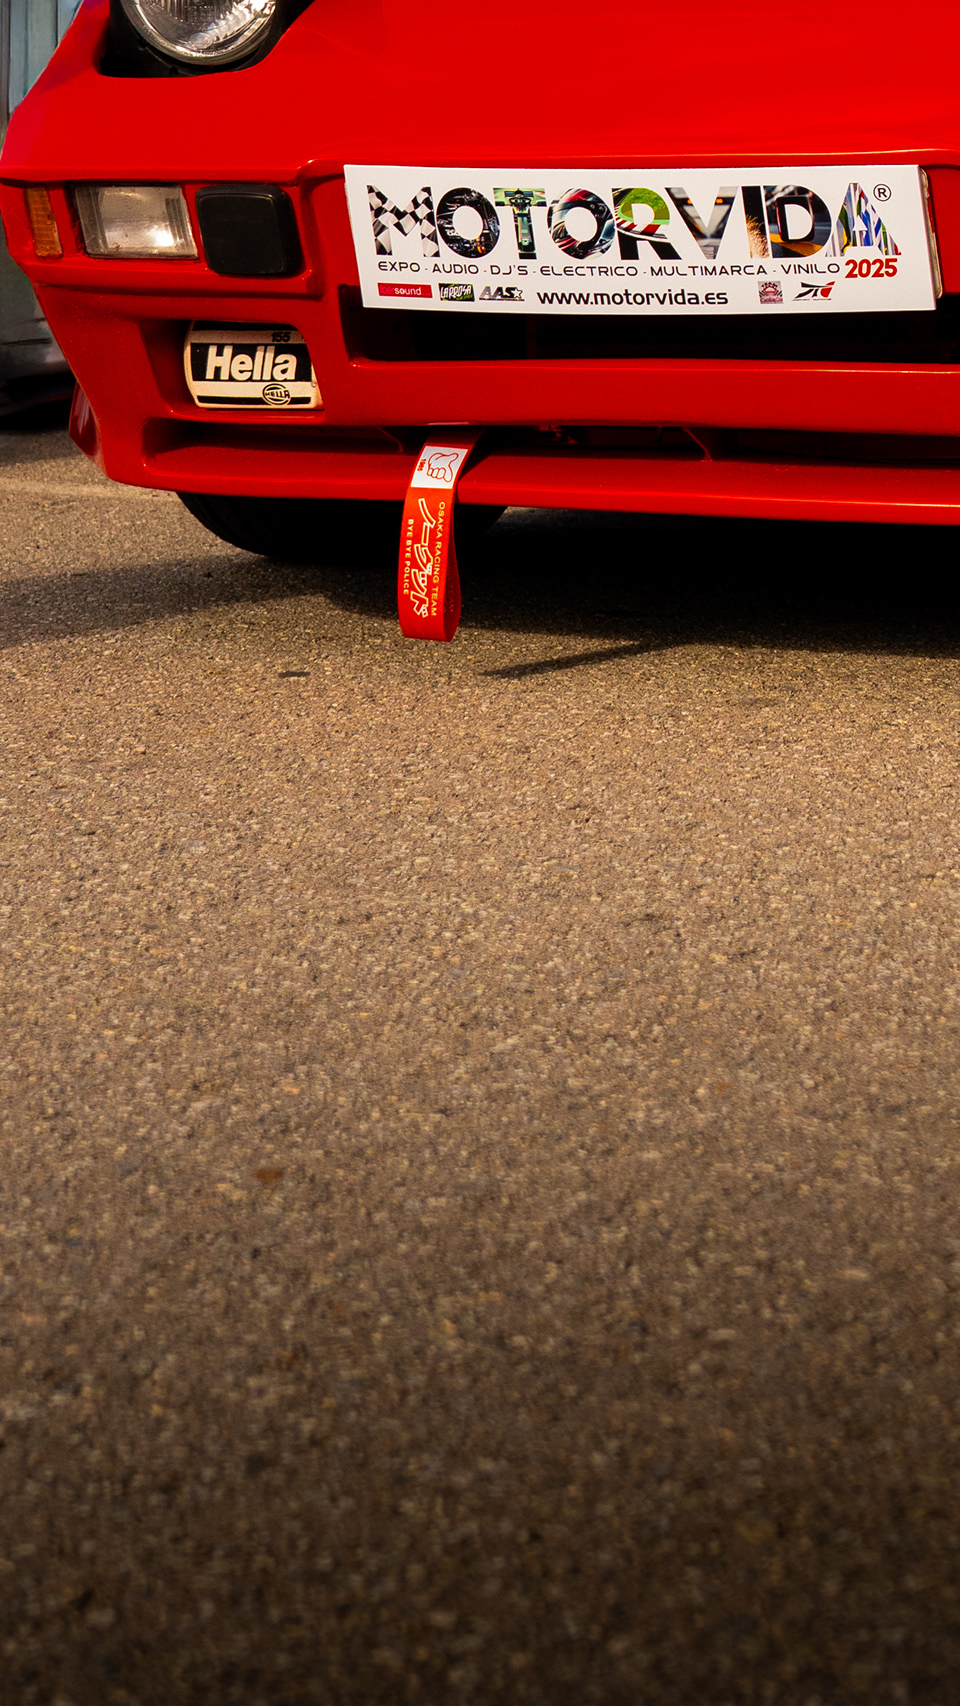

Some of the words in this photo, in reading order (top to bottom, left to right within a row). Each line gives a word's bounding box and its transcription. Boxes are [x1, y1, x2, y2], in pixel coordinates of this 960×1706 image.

[366, 183, 902, 261] MOTORVIDA
[378, 261, 421, 273] EXPO
[432, 263, 479, 275] AUDIO
[490, 264, 528, 276] DJ'S
[540, 265, 638, 277] ELECTRICO
[650, 264, 768, 278] MULTIMARCA
[781, 263, 840, 275] VINILO
[844, 258, 898, 279] 2025
[537, 289, 729, 307] www.motorvida.es
[271, 332, 291, 342] 155
[206, 345, 297, 381] Hella
[265, 390, 290, 399] HELLA
[435, 502, 446, 539] OSAKA
[403, 560, 411, 595] POLICE
[432, 544, 442, 584] RACING
